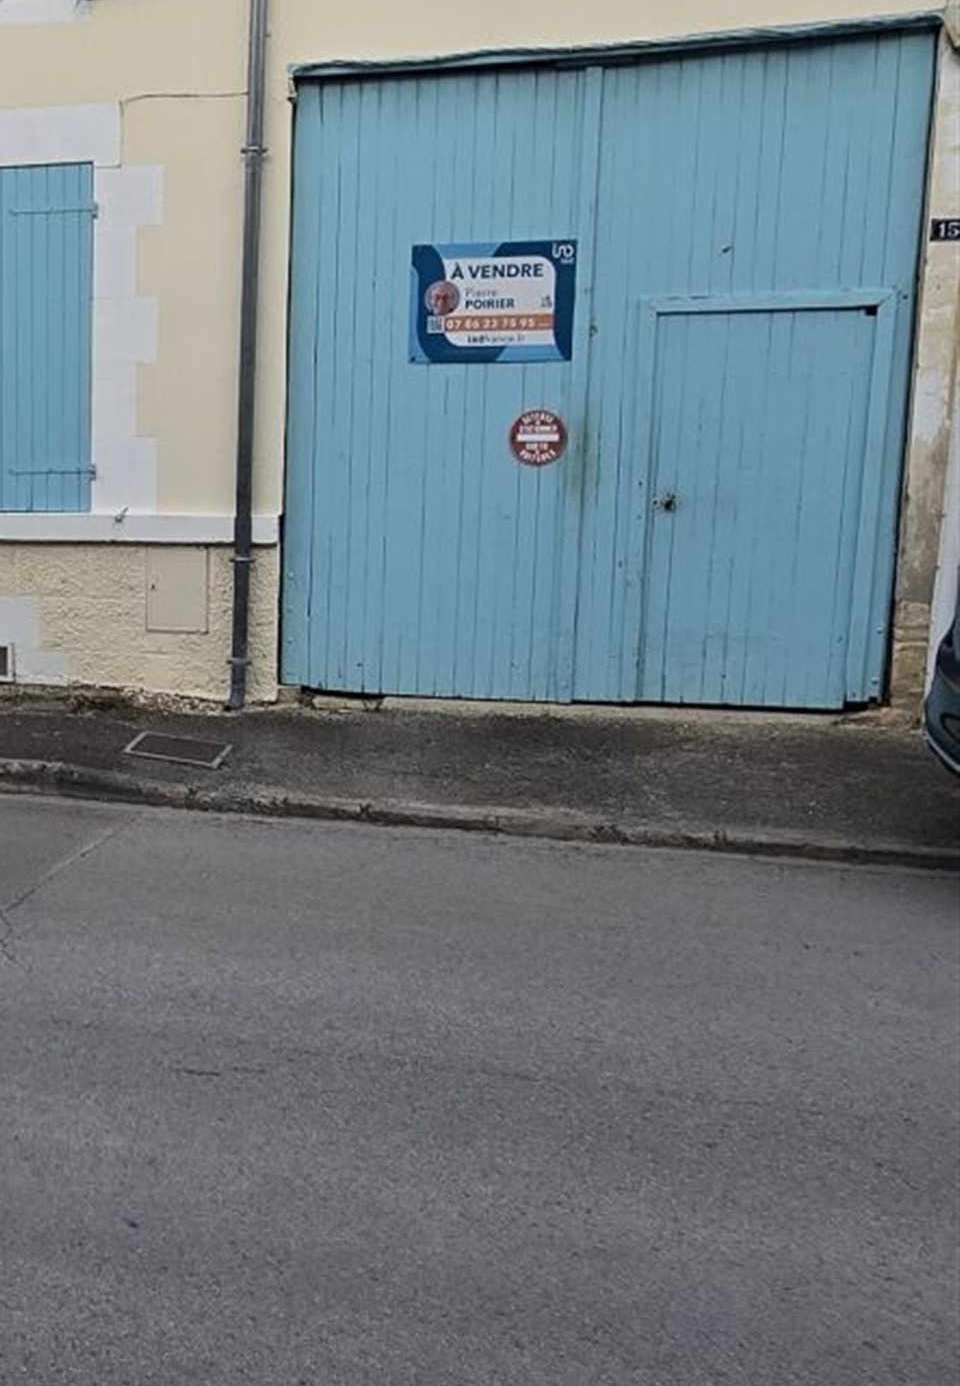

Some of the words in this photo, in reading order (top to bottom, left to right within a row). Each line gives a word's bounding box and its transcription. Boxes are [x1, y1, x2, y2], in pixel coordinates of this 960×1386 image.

[451, 262, 464, 280] À
[468, 263, 544, 279] VENDRE
[465, 298, 515, 310] POIRIER
[446, 319, 461, 330] 07
